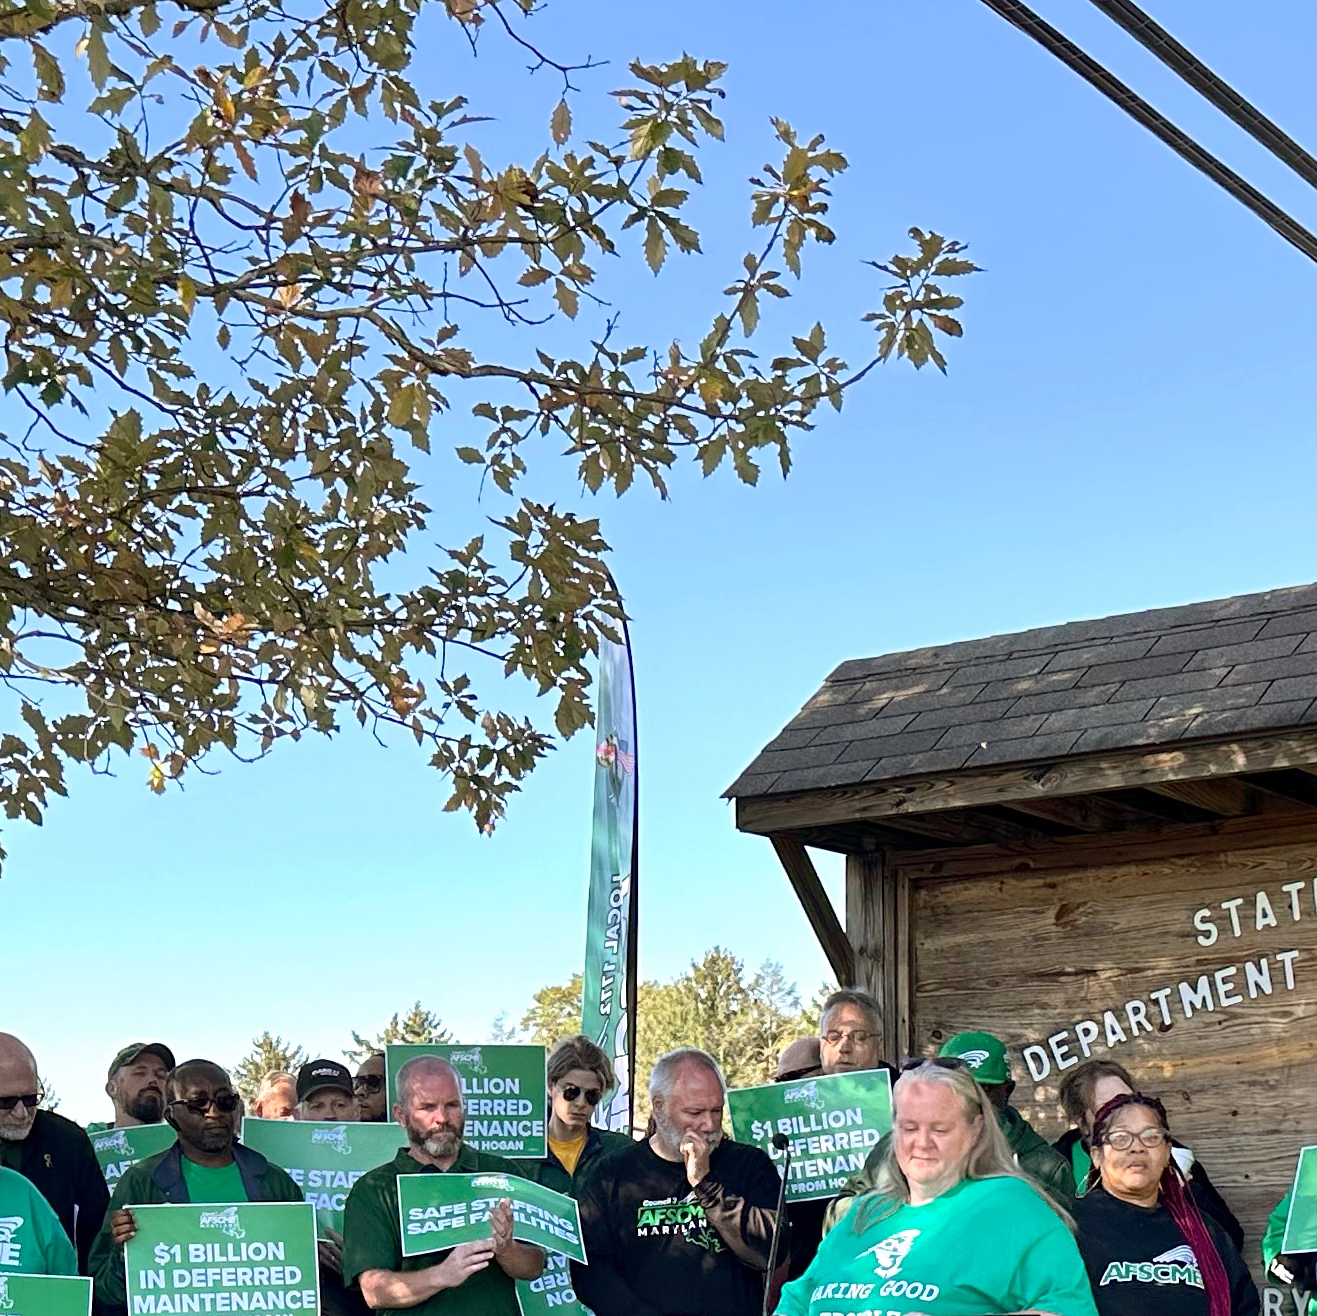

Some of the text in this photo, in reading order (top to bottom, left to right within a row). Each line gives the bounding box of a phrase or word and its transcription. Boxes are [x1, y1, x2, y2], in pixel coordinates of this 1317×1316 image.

[1023, 950, 1299, 1082] DEPARTMENT
[751, 1108, 862, 1141] $1 BILLION
[482, 1141, 523, 1150] HOGAN
[791, 1180, 826, 1194] FROM
[408, 1203, 467, 1220] SAFE
[407, 1210, 579, 1245] SAFE FAILITIES
[154, 1242, 284, 1266] $1 BILLION
[139, 1266, 301, 1289] IN DEFERRED
[134, 1290, 315, 1314] MAINTENANCE
[879, 1280, 939, 1302] GOOD
